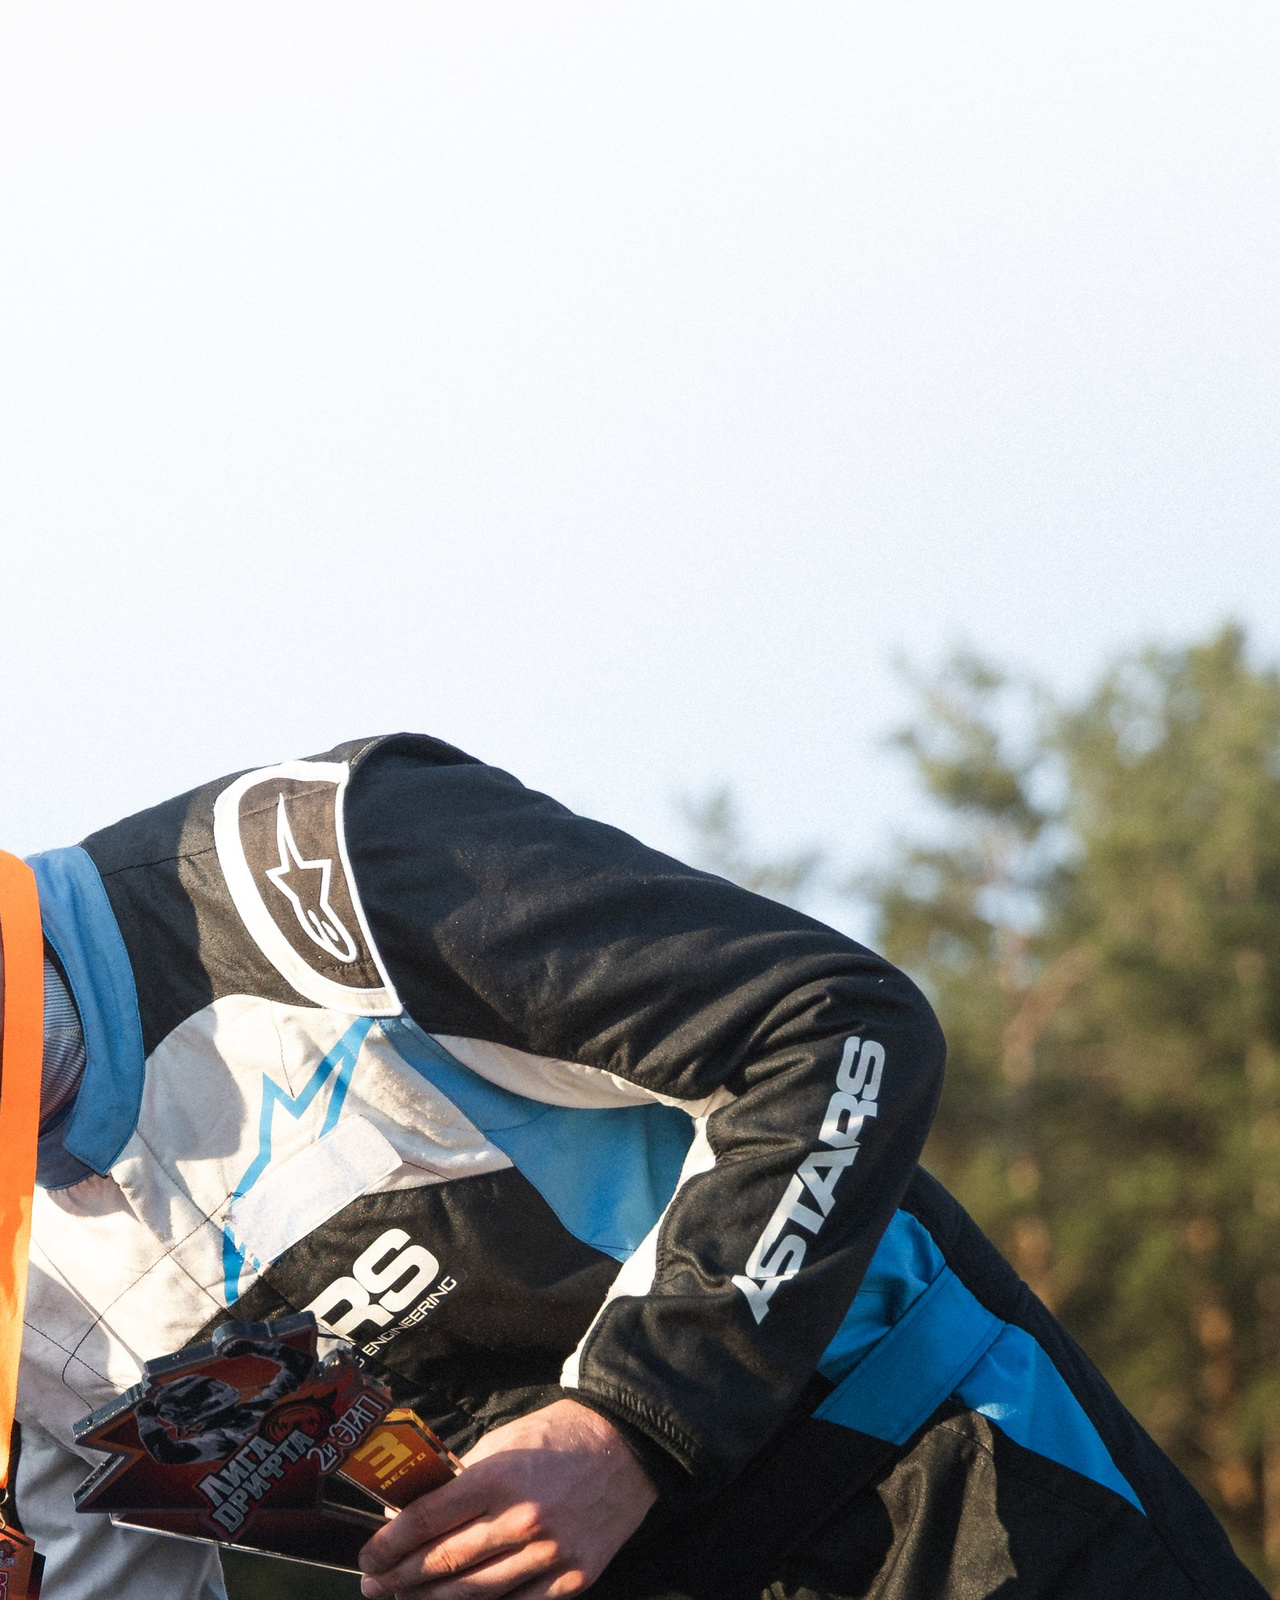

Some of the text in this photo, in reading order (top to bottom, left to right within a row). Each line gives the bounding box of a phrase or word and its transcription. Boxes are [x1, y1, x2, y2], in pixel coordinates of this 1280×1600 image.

[361, 1275, 458, 1357] ENGINEERING
[328, 1394, 383, 1447] ЭТАП
[198, 1435, 276, 1506] ЛИГА
[353, 1431, 413, 1481] 3
[379, 1452, 427, 1491] МЕСТО
